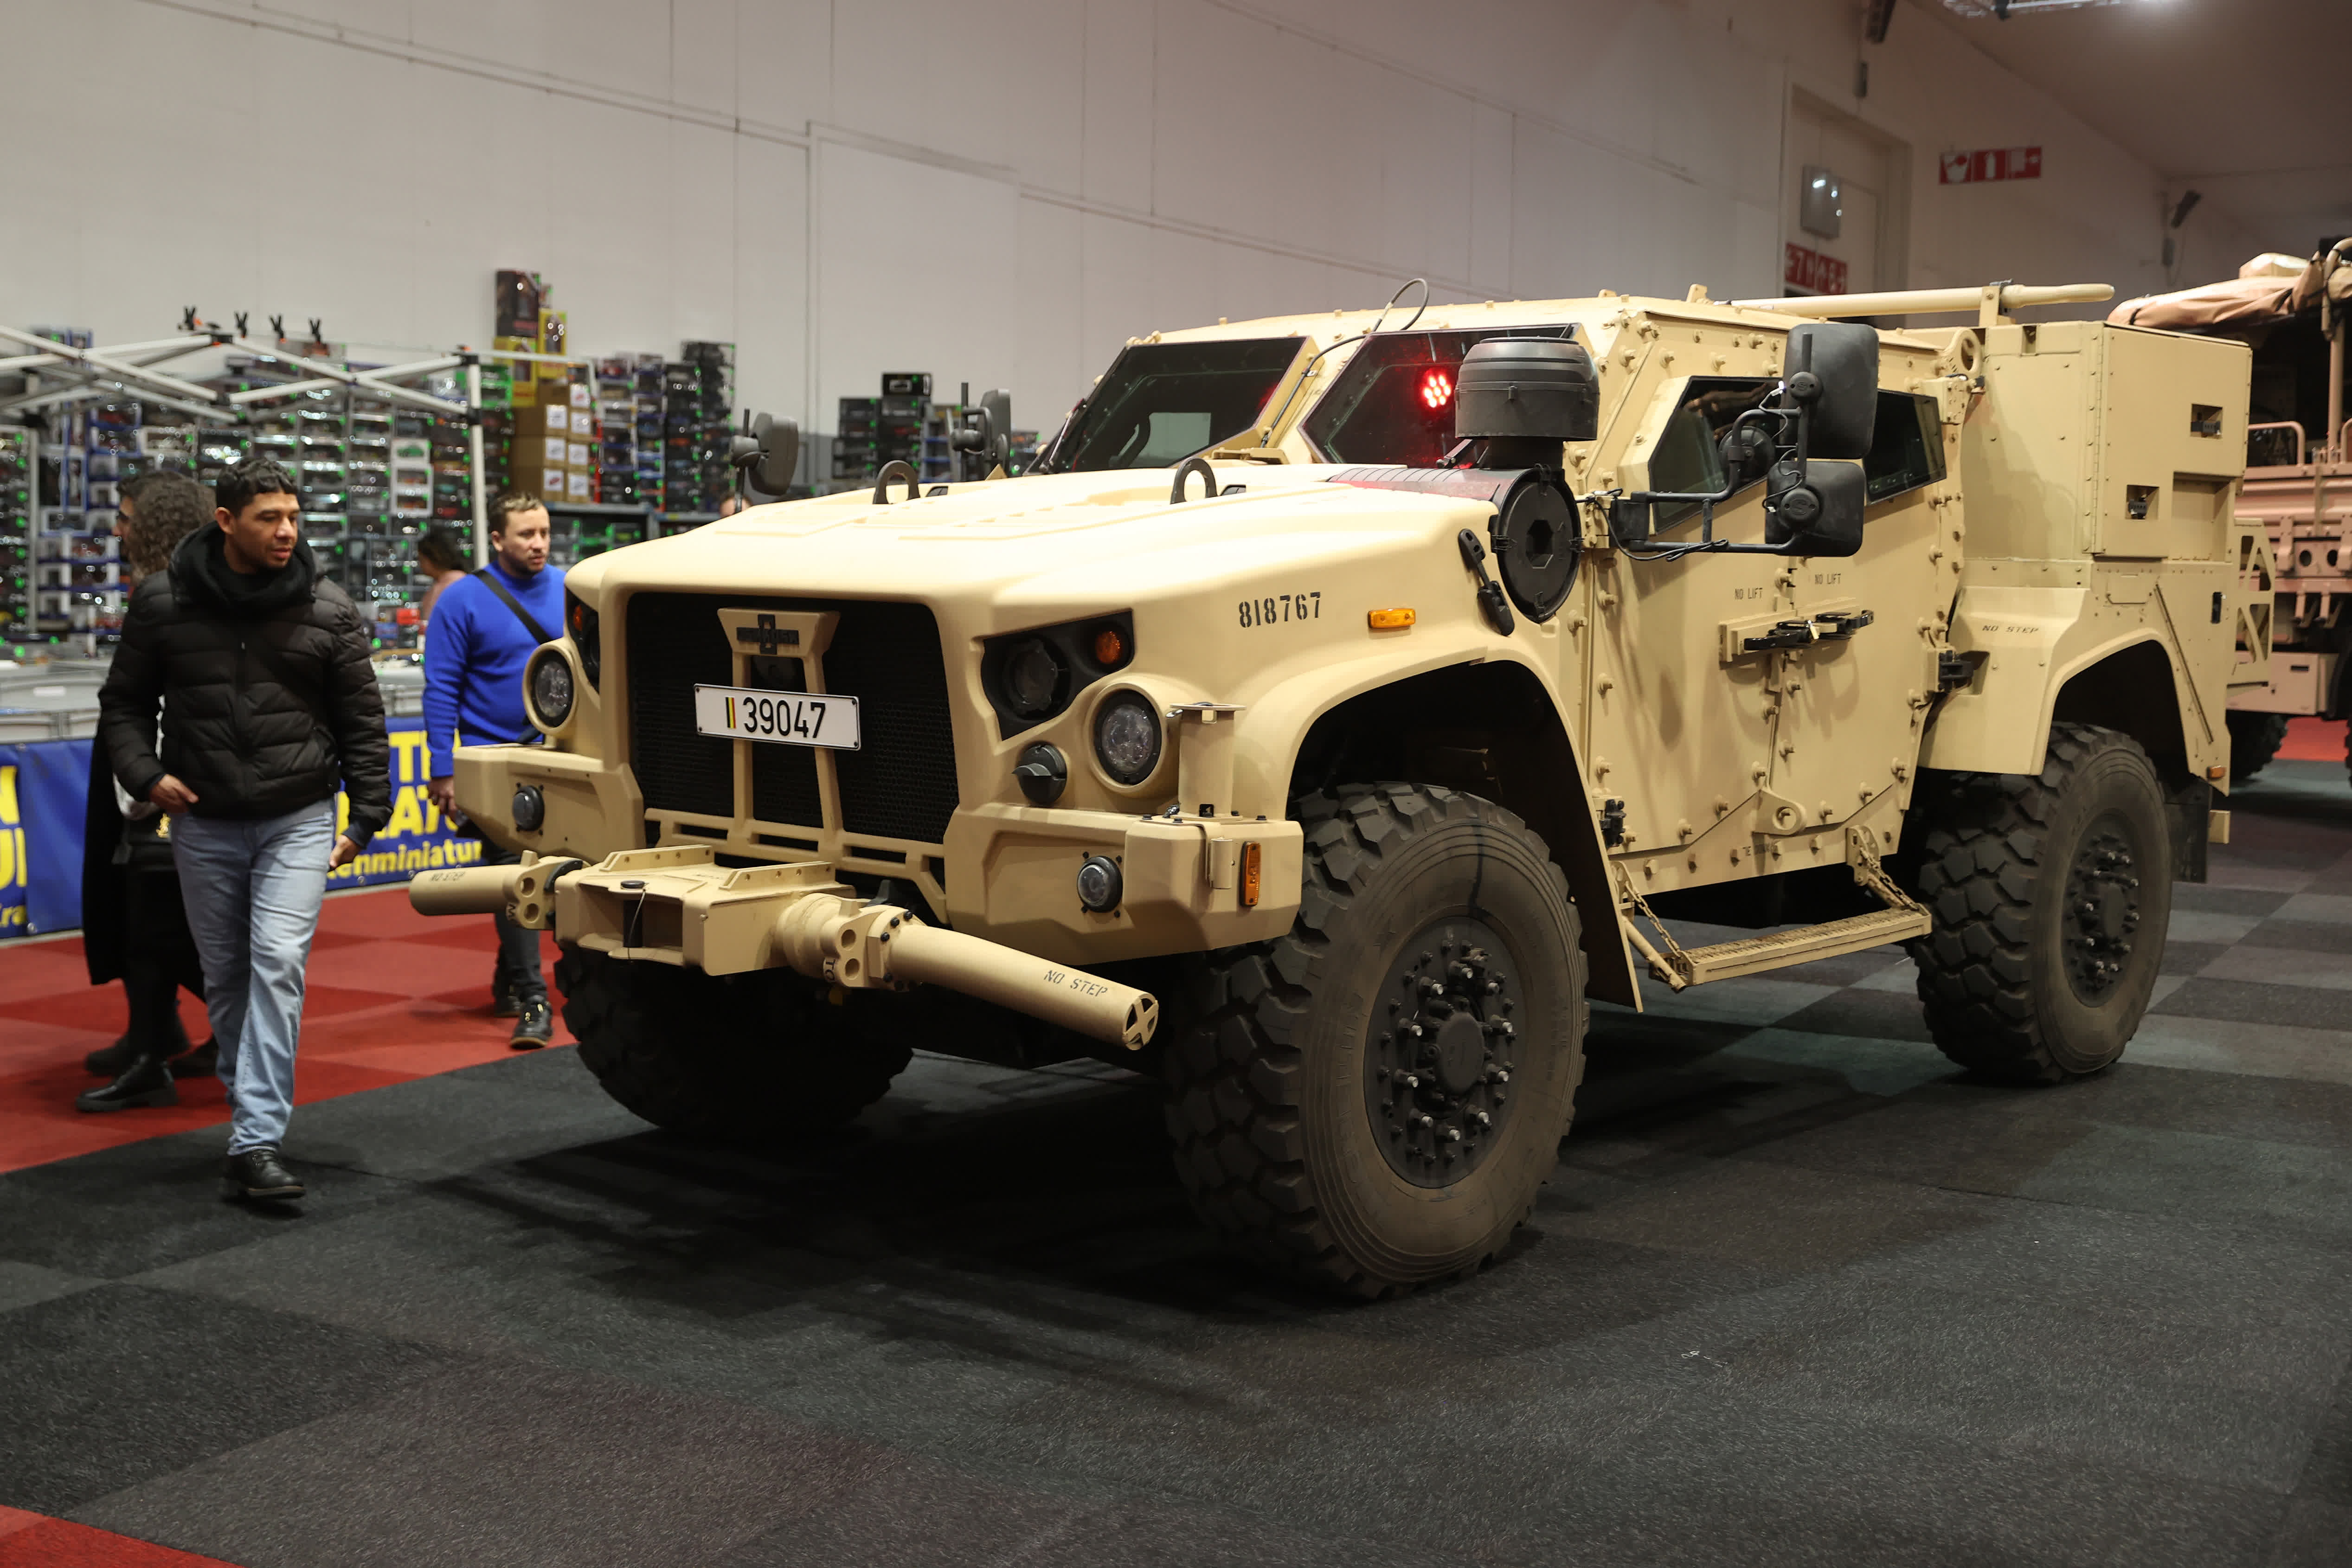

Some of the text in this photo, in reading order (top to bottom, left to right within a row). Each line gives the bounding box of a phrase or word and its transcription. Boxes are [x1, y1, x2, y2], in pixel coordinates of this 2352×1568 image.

[1814, 573, 1841, 585] NO LIFT
[1735, 587, 1762, 599] NO LIFT
[1239, 591, 1321, 628] 818767
[742, 697, 826, 739] 39047
[1043, 970, 1108, 997] NO STEP
